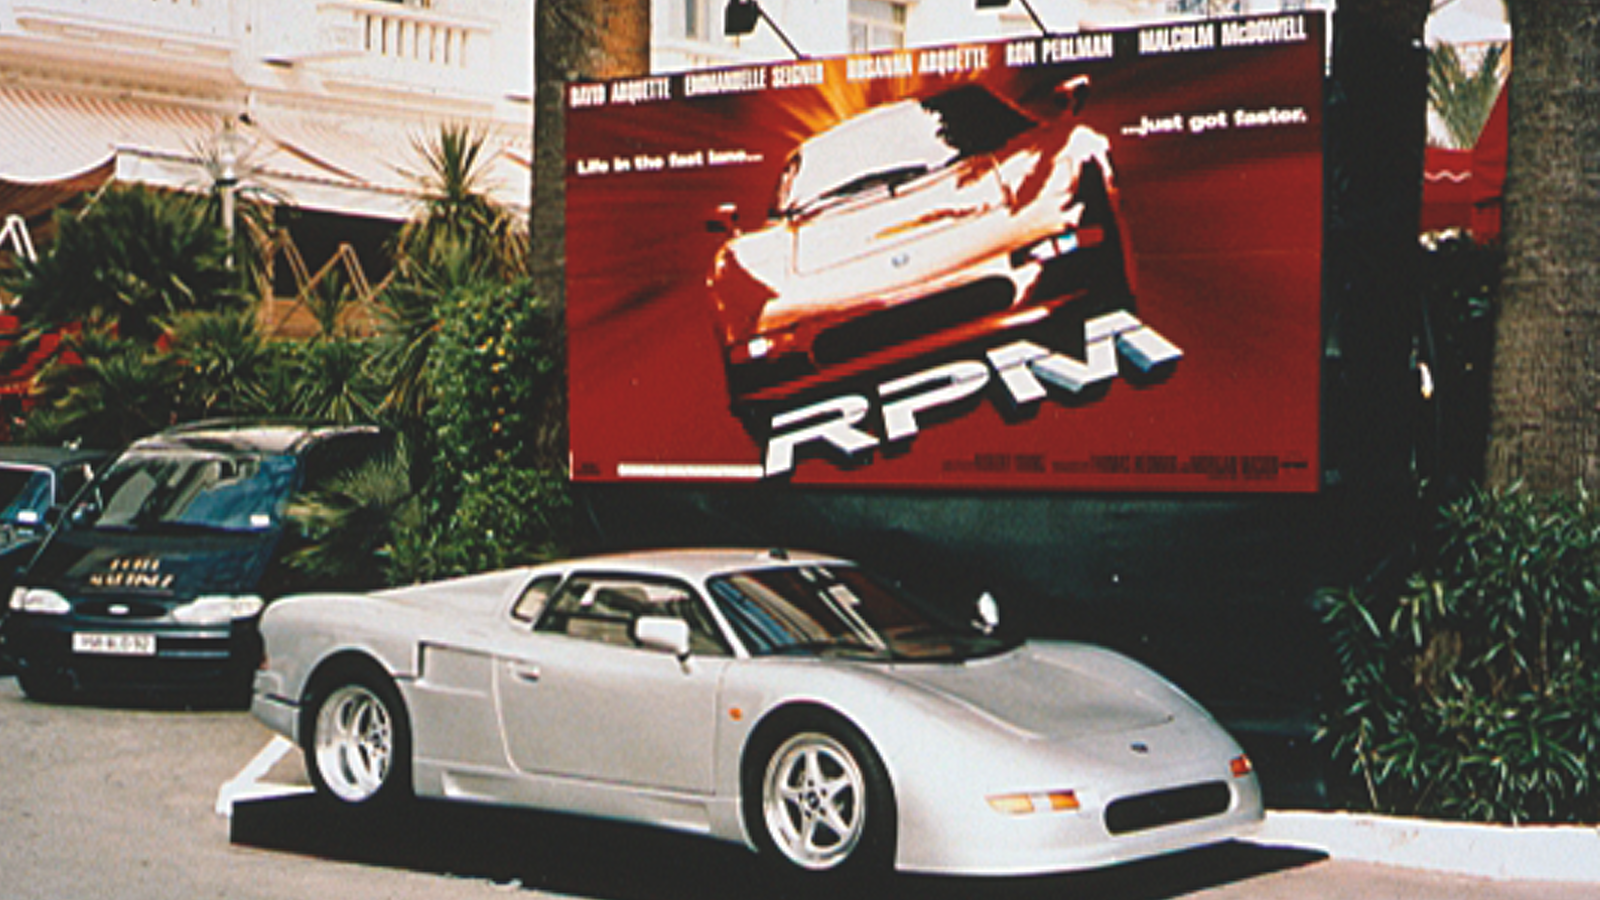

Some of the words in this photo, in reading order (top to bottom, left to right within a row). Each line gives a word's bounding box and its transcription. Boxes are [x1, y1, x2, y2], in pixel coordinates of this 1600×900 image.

[1042, 34, 1113, 63] PERLMAN
[1138, 24, 1215, 54] MALCOLM
[1189, 110, 1228, 133] got
[613, 157, 631, 171] in
[634, 155, 665, 170] the
[668, 151, 704, 168] fast
[765, 309, 1184, 477] RPM
